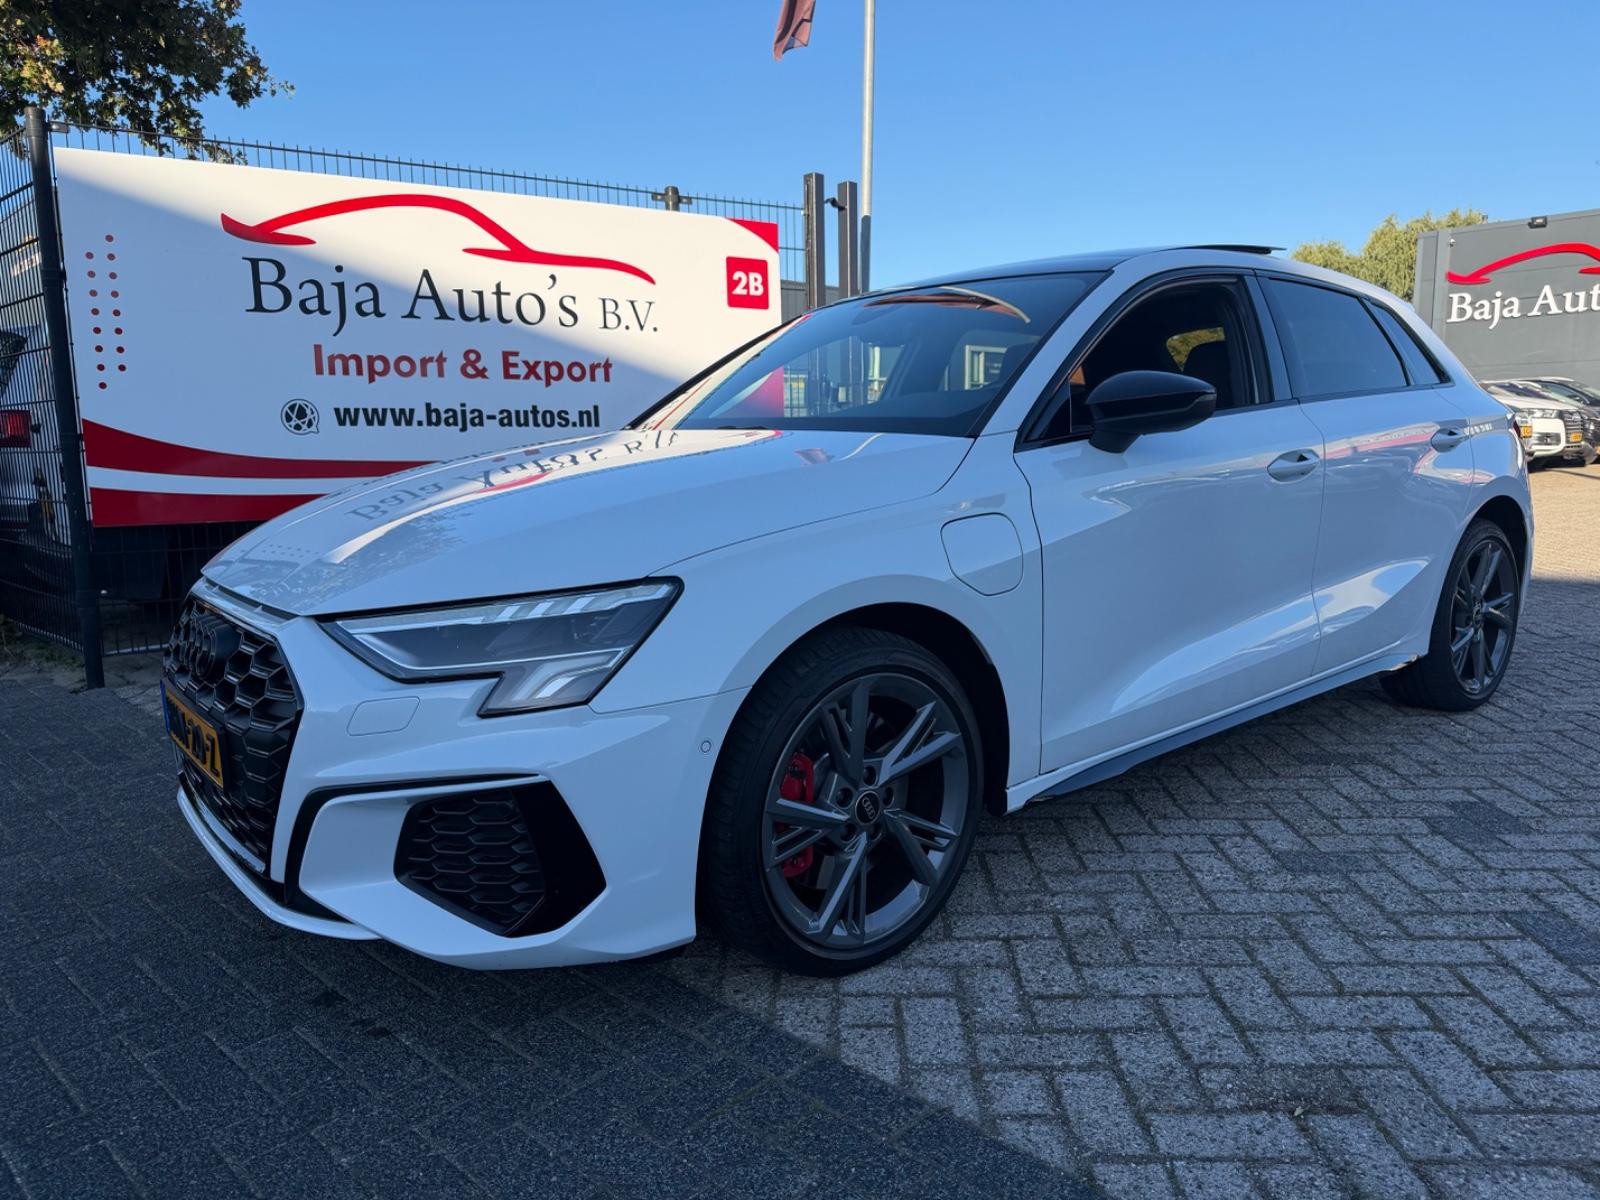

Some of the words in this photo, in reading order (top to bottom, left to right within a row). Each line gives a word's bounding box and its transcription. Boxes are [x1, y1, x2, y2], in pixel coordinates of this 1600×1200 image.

[242, 256, 386, 337] Baja
[401, 268, 579, 328] Auto's
[600, 297, 659, 332] B.V.
[731, 271, 764, 296] 2B
[1446, 290, 1522, 329] Baja
[1527, 283, 1600, 316] Aut
[313, 343, 447, 385] Import
[460, 349, 489, 380] &
[501, 351, 613, 388] Export
[334, 401, 600, 433] www.baja-autos.nl
